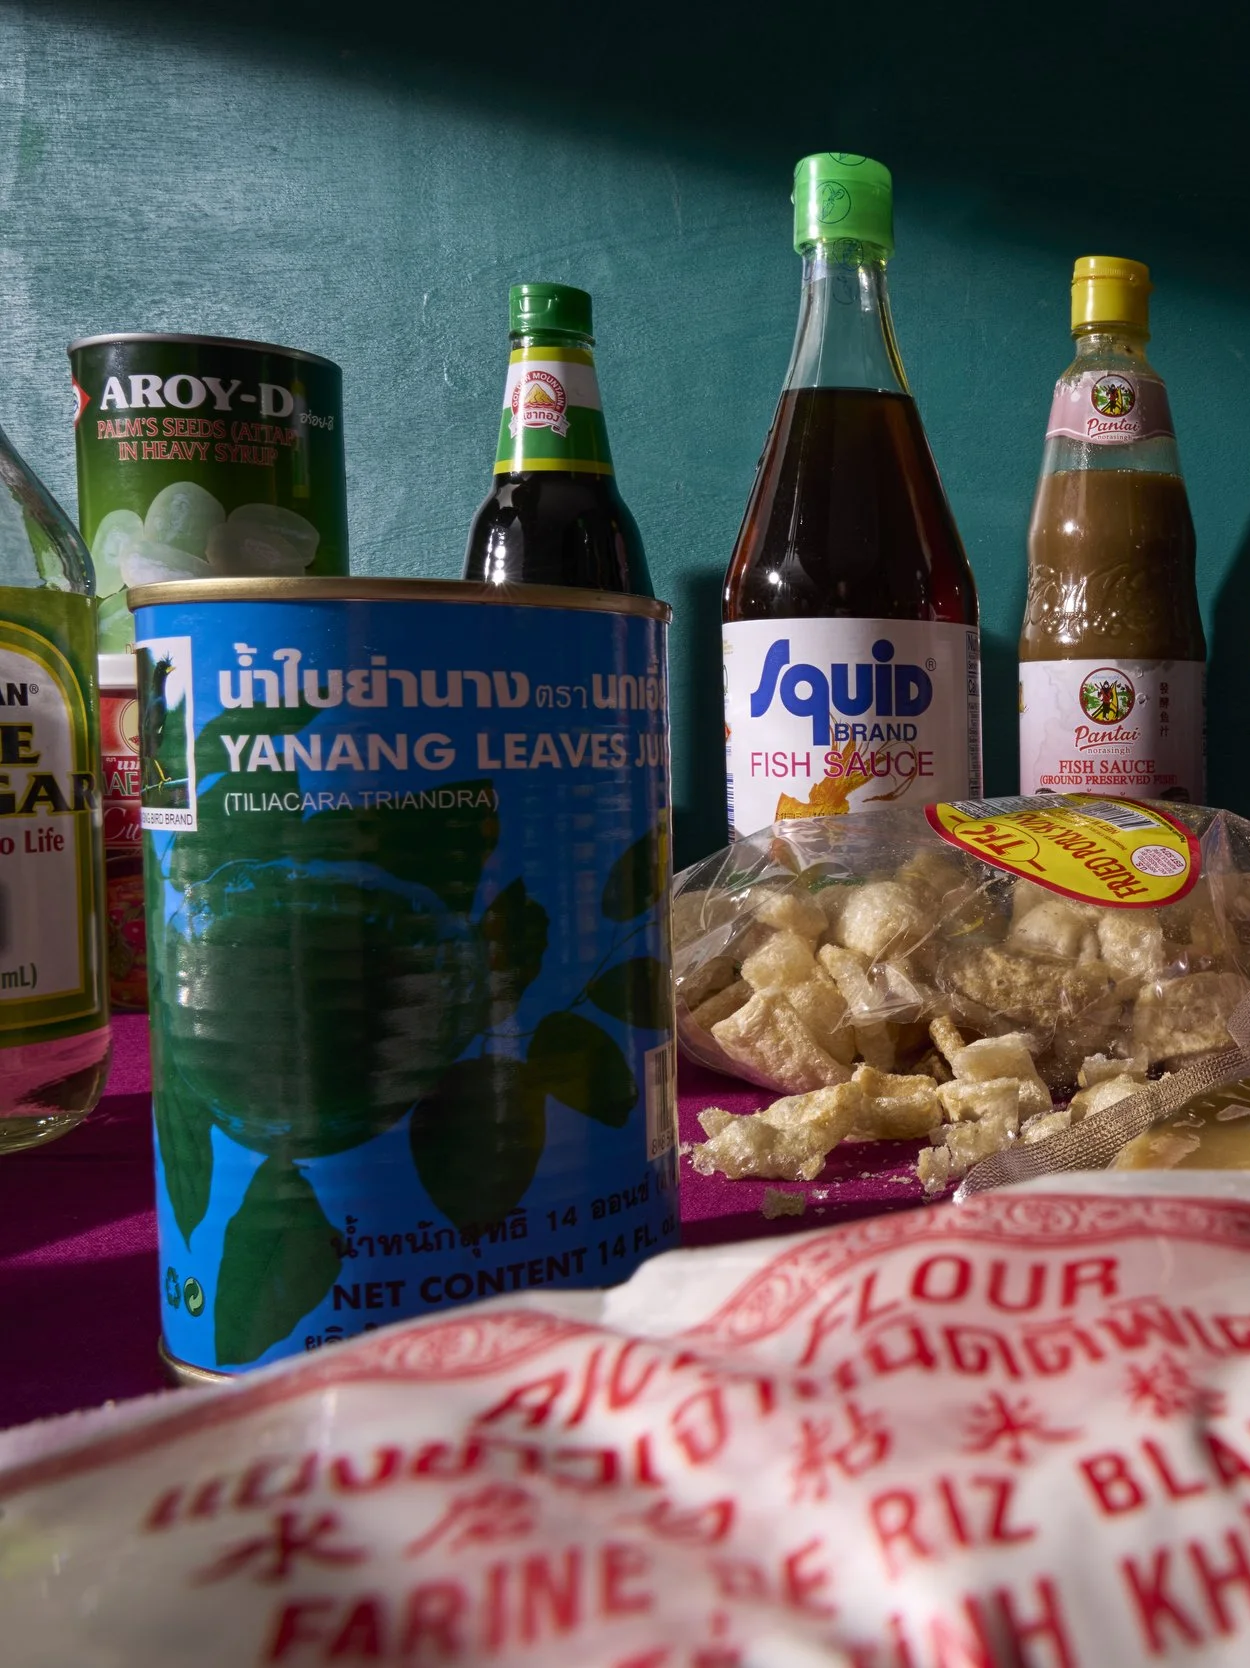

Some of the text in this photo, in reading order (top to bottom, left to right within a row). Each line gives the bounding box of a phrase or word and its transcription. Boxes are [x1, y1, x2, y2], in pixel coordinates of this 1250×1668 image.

[100, 374, 294, 418] AROY-D
[532, 372, 565, 407] MOUNTAIN
[97, 417, 158, 440] PALM'S
[163, 417, 227, 440] SEEDS
[1087, 418, 1139, 435] Pantai
[119, 442, 278, 467] IN HEAVY SYRUP
[219, 642, 588, 709] น้ำใบย่านาง ตรา
[834, 723, 917, 743] BRAND
[1075, 724, 1138, 748] Pantai
[221, 732, 627, 772] YANANG LEAVES
[1088, 746, 1131, 755] norasingh
[751, 751, 934, 778] FISH SAUCE
[1059, 760, 1155, 774] FISH SAUCE
[1040, 775, 1083, 786] (GROUND
[1085, 775, 1150, 785] PRESERVED
[224, 787, 499, 813] (TILIACARA TRIANDRA)
[165, 813, 193, 826] BRAND
[25, 827, 64, 854] Life
[959, 823, 1025, 856] TFC
[1052, 825, 1107, 860] PORK
[1083, 850, 1150, 900] FRIED
[547, 1205, 578, 1232] 14
[333, 1226, 657, 1311] NET CONTENT 14 FL.
[799, 1253, 1119, 1370] FLOUR
[261, 1542, 656, 1667] FARINE
[868, 1472, 1036, 1580] RIZ
